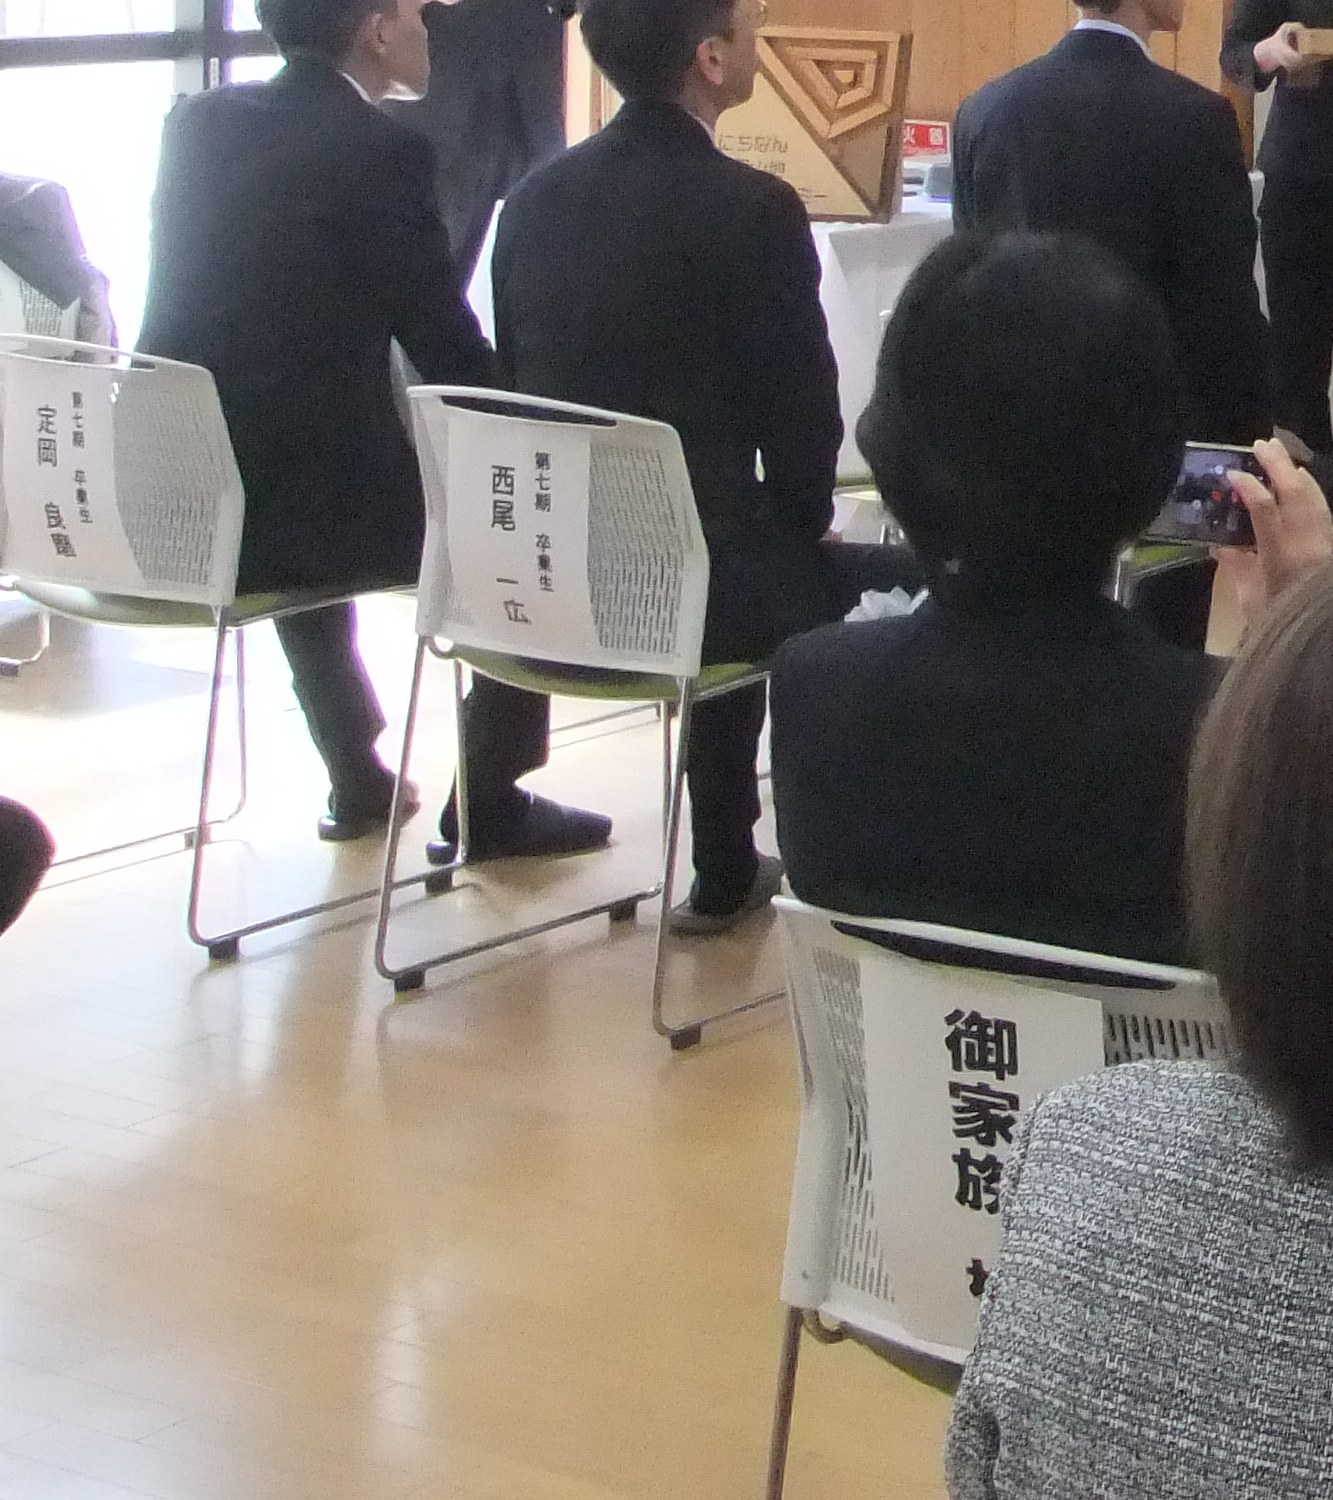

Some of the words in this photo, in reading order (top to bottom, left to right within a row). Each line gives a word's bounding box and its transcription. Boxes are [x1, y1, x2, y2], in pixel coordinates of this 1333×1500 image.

[36, 405, 58, 467] 定岡
[491, 465, 516, 531] 西尾
[534, 452, 551, 513] 第七期
